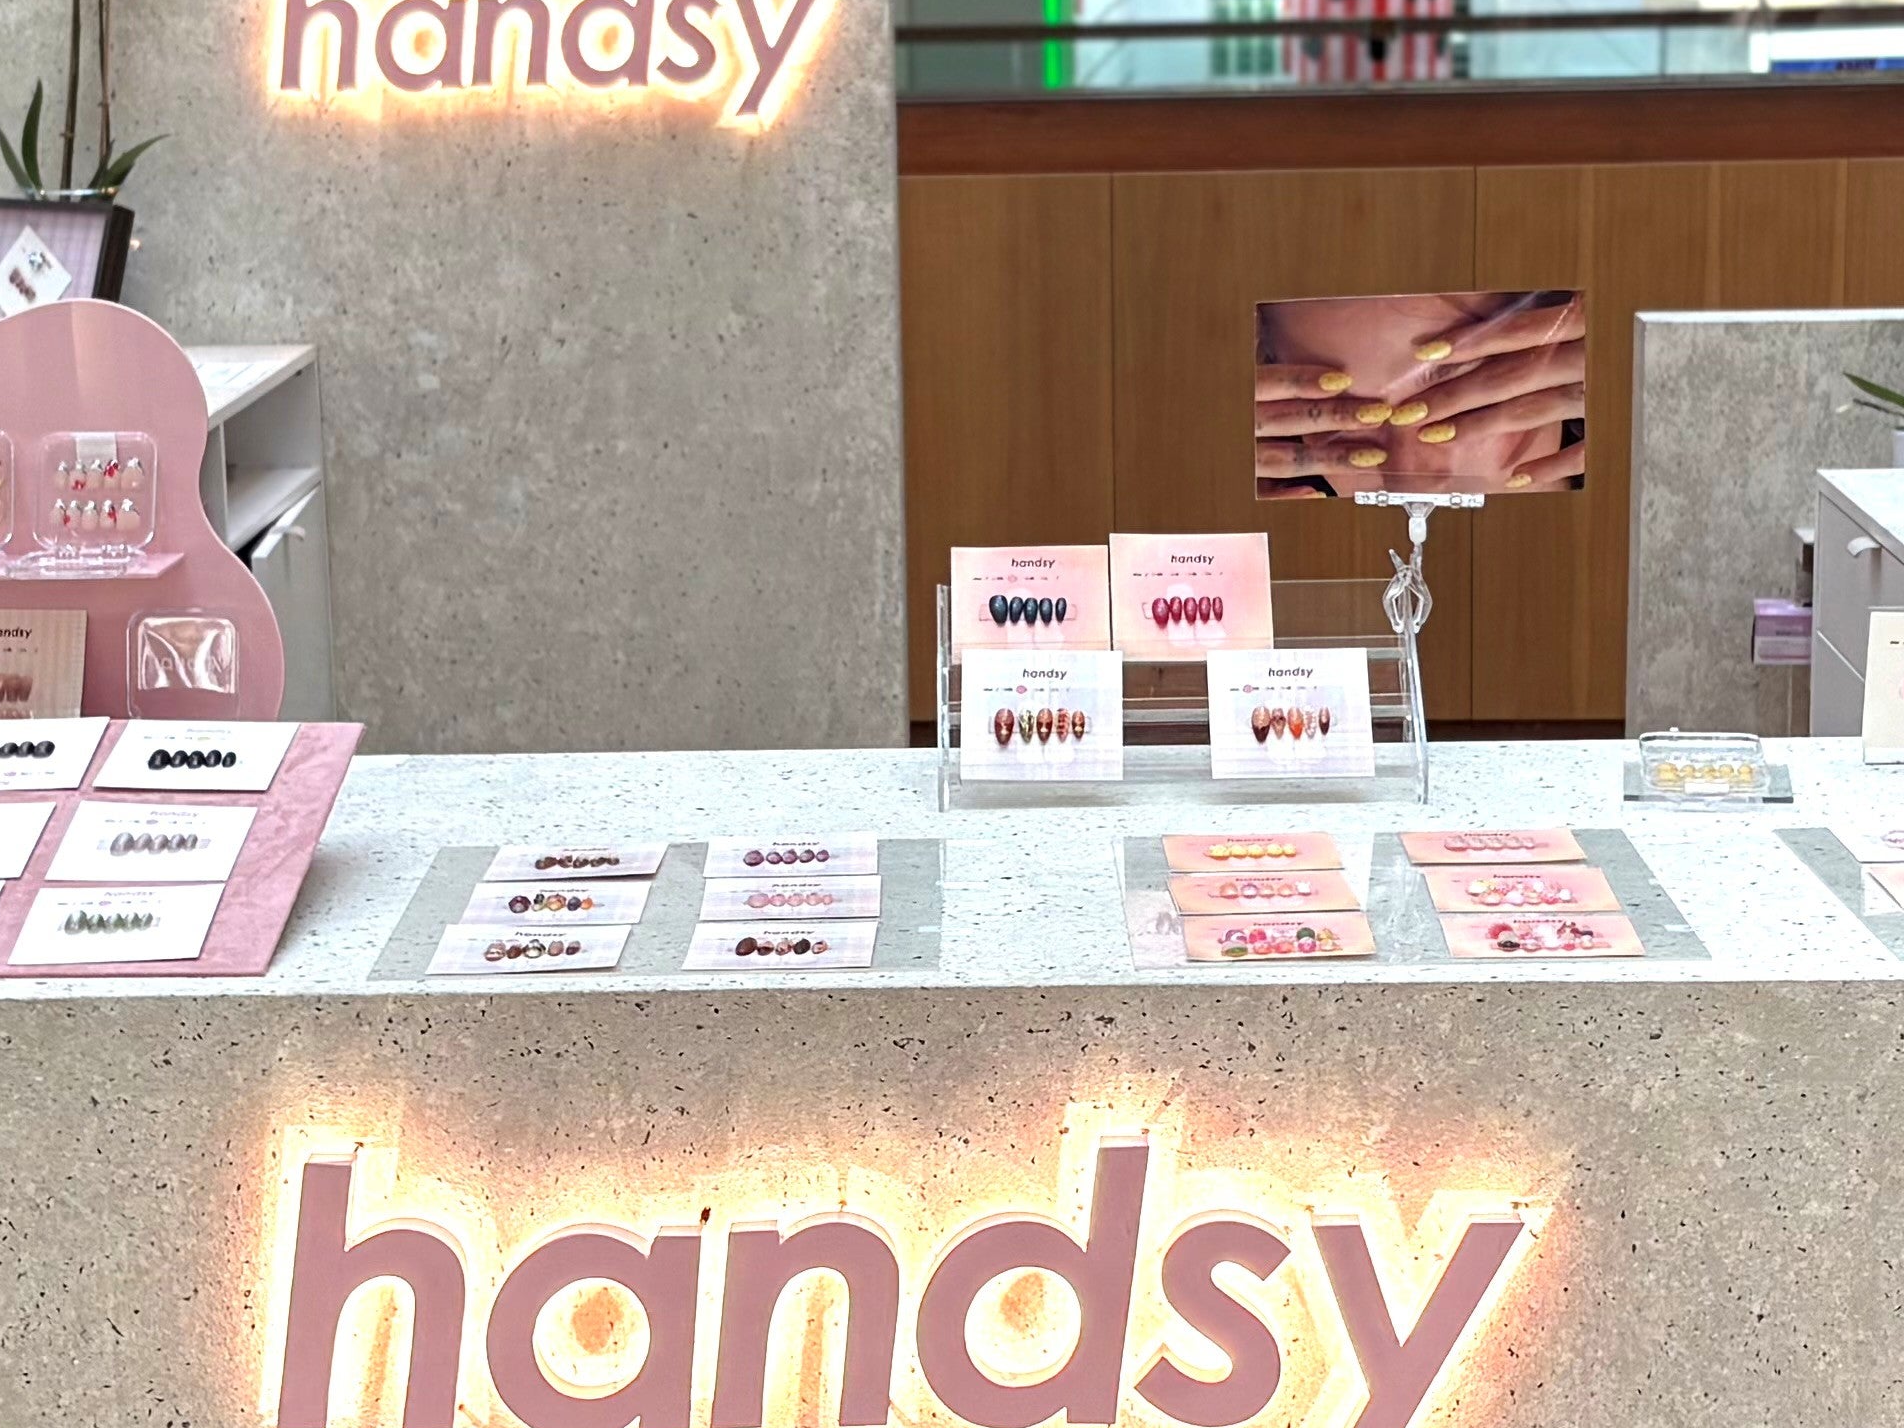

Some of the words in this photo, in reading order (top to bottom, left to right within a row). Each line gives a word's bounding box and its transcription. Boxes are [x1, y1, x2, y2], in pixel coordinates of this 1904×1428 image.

[1011, 557, 1056, 569] handsy
[1170, 553, 1215, 566] handsy
[1022, 668, 1067, 681] handsy
[1268, 666, 1314, 679] handsy
